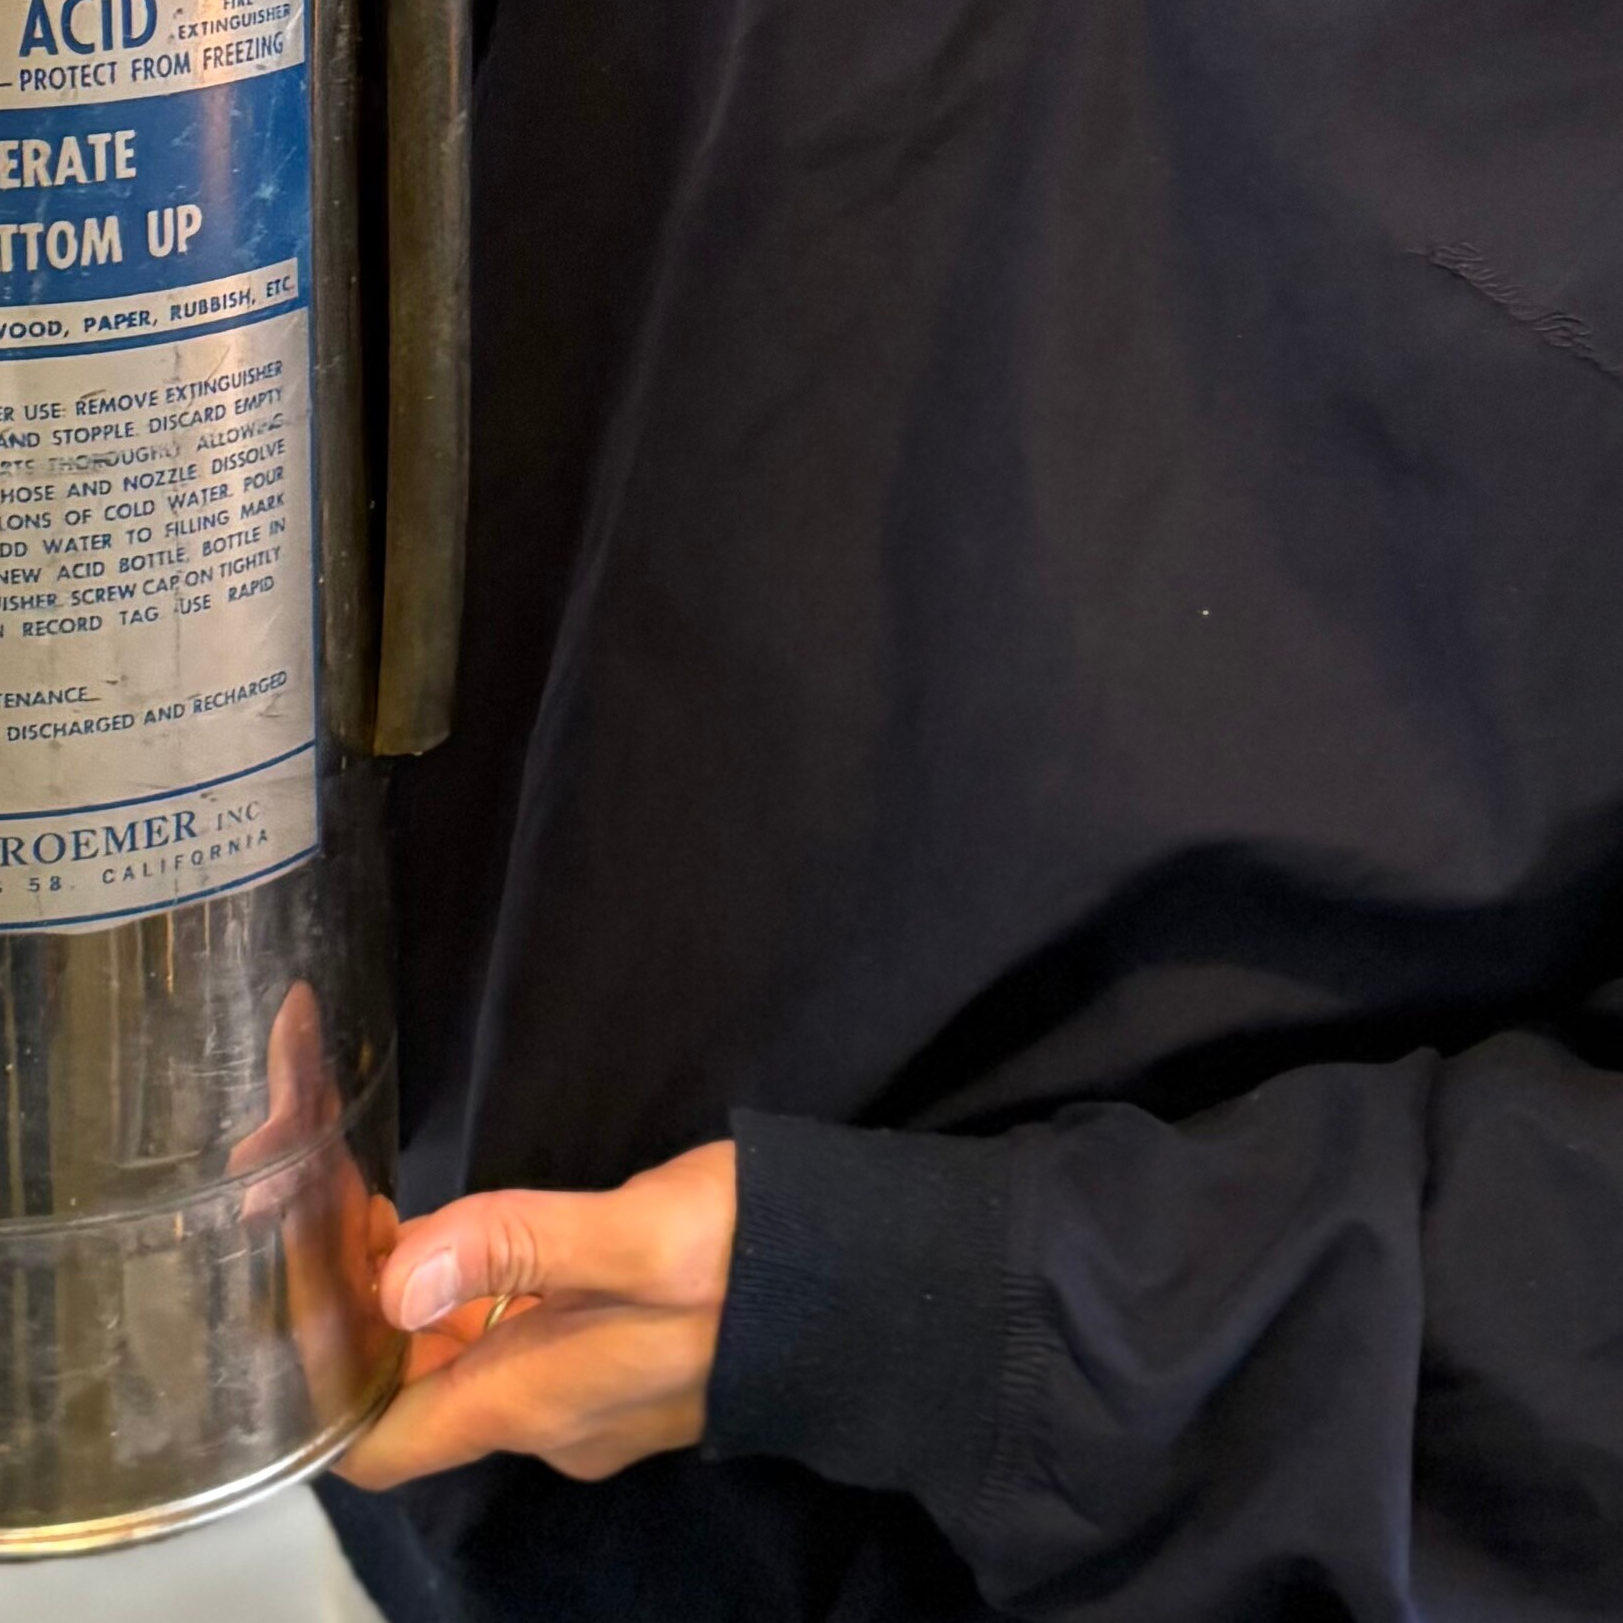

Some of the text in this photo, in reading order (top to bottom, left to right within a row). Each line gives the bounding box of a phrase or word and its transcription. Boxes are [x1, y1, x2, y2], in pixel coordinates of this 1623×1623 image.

[178, 3, 291, 40] EXTINGUISHER
[20, 61, 118, 91] PROTECT
[131, 53, 191, 82] FROM
[203, 31, 283, 70] FREEZING
[146, 204, 201, 257] UP
[84, 310, 159, 333] PAPER,
[170, 288, 256, 321] RUBBISH,
[76, 389, 158, 416] REMOVE
[166, 360, 283, 403] EXTINGUISHER
[149, 404, 226, 434] DISCARD
[235, 387, 283, 414] EMPTY
[0, 485, 55, 504] HOSE
[67, 479, 112, 497] AND
[212, 439, 285, 475] DISSOLVE
[65, 509, 92, 526] OF
[104, 499, 155, 521] COLD
[243, 466, 284, 492] POUR
[43, 533, 112, 554] WATER
[126, 527, 152, 545] TO
[165, 509, 230, 539] FILLING
[239, 491, 285, 519] MARK
[56, 561, 105, 582] ACID
[201, 525, 261, 556] BOTTLE
[269, 518, 287, 537] IN
[71, 583, 136, 607] SCREW
[142, 575, 179, 596] CAP
[185, 568, 214, 587] ON
[219, 545, 281, 578] TIGHTLY
[22, 615, 103, 638] RECORD
[119, 605, 159, 627] TAG
[179, 594, 212, 615] USE
[228, 575, 275, 603] RAPID
[7, 713, 135, 742] DISCHARGED
[143, 703, 185, 726] AND
[192, 670, 287, 713] RECHARGED
[102, 828, 269, 885] CALIFORNIA
